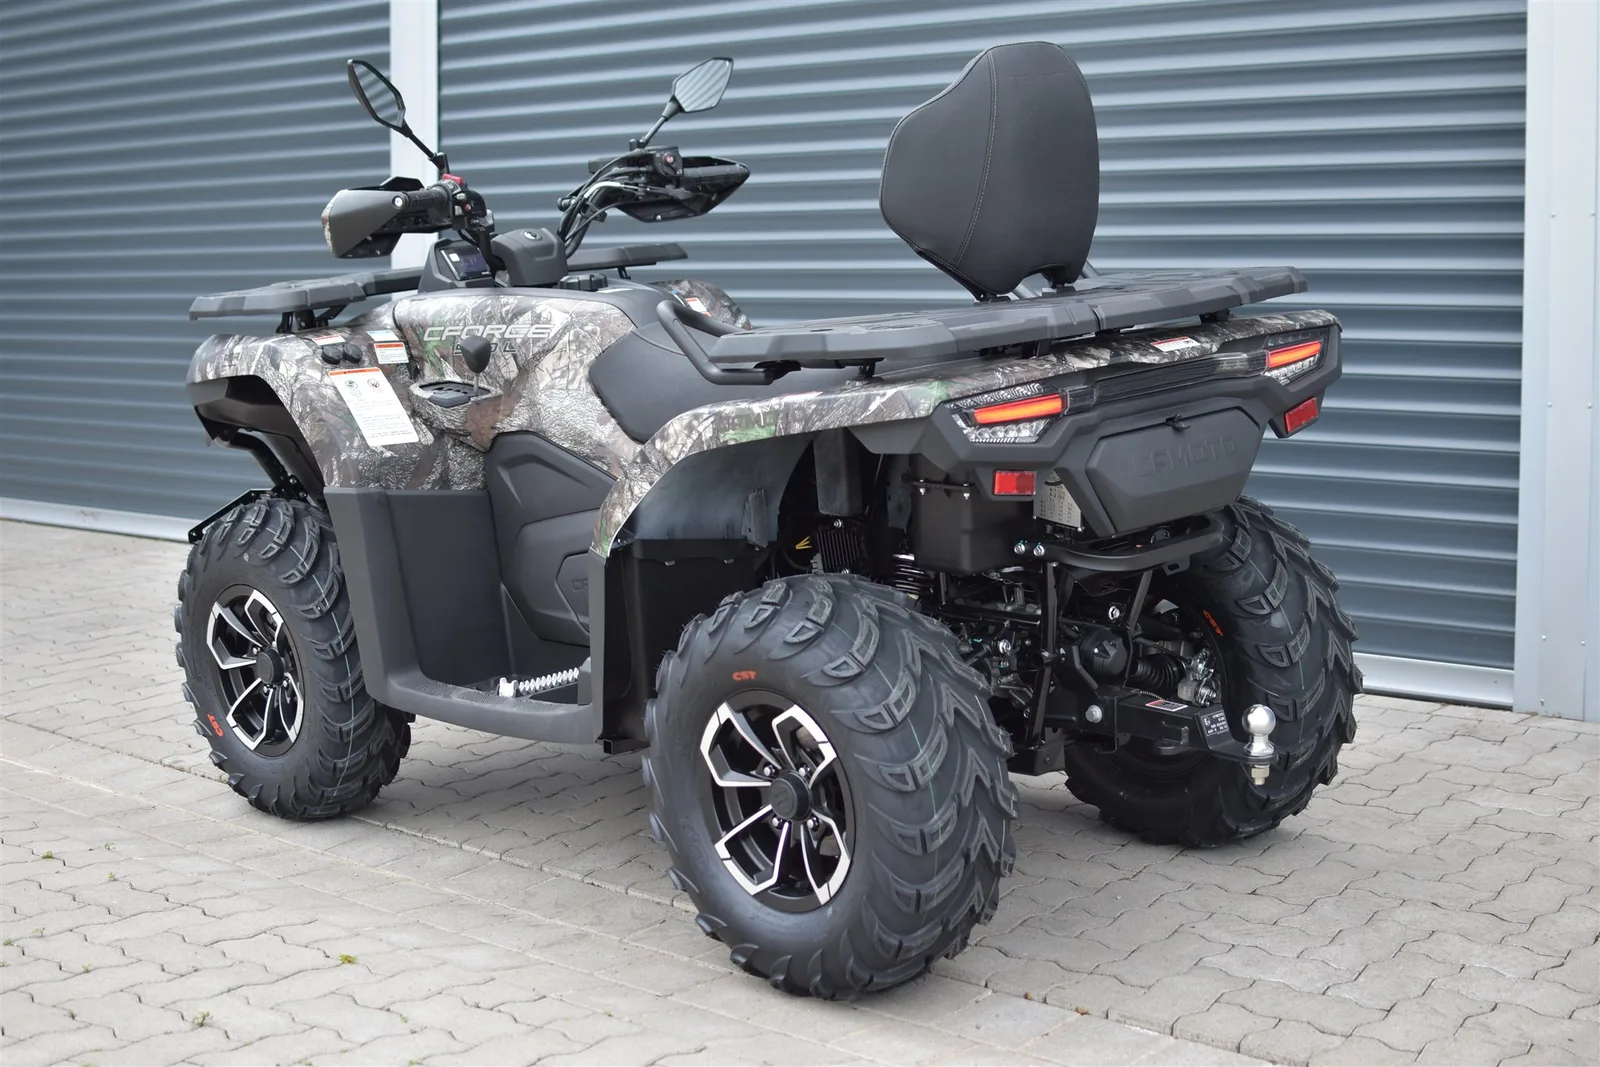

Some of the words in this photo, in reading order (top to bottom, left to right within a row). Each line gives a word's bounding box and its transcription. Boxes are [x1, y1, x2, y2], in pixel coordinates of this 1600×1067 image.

[423, 324, 554, 341] CFORCE
[1132, 435, 1238, 477] CFMOTO
[732, 670, 757, 681] CST
[207, 712, 224, 737] CST
